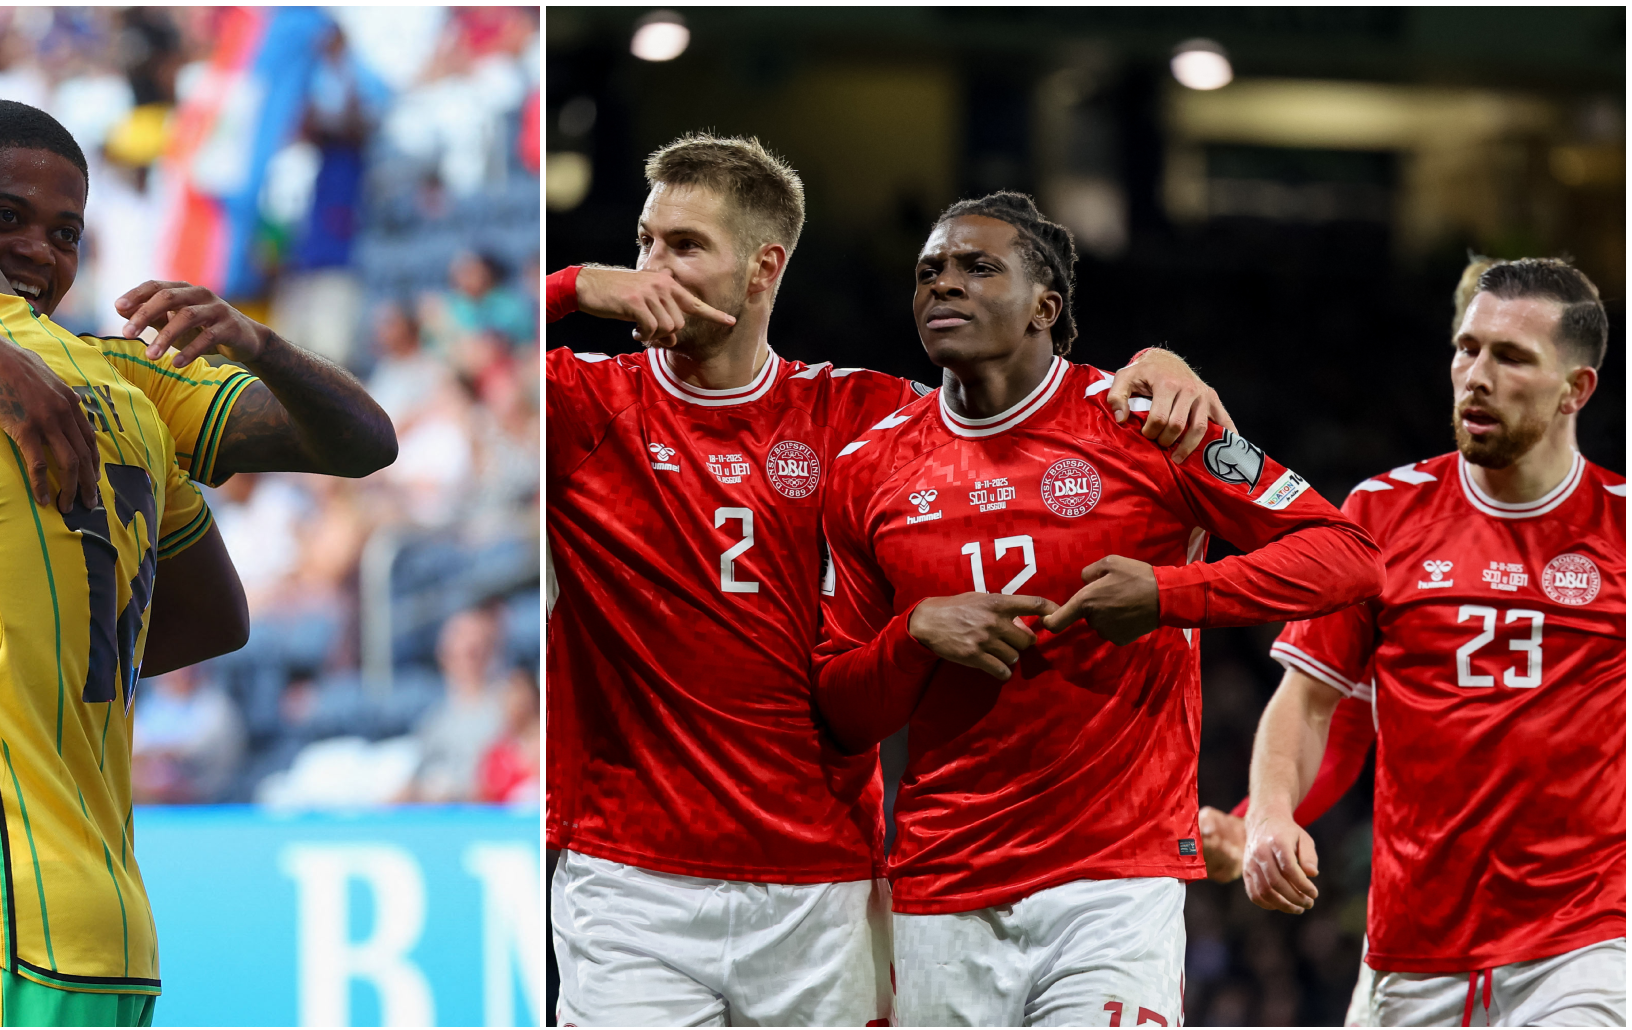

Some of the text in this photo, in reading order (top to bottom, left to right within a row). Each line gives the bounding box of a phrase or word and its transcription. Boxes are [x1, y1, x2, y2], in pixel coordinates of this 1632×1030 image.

[730, 462, 751, 475] DEN
[777, 459, 810, 477] DBU
[974, 477, 1009, 490] 18-11-2025
[1053, 477, 1089, 497] DBU
[969, 490, 988, 506] SCO
[996, 486, 1016, 501] DEN
[979, 501, 1007, 513] GLASGOW
[906, 509, 942, 525] hummel
[714, 506, 759, 593] 2
[961, 534, 1037, 597] 12
[1482, 569, 1501, 583] SCO
[1509, 573, 1528, 587] DEN
[1554, 571, 1588, 589] DBU
[1455, 604, 1545, 688] 23
